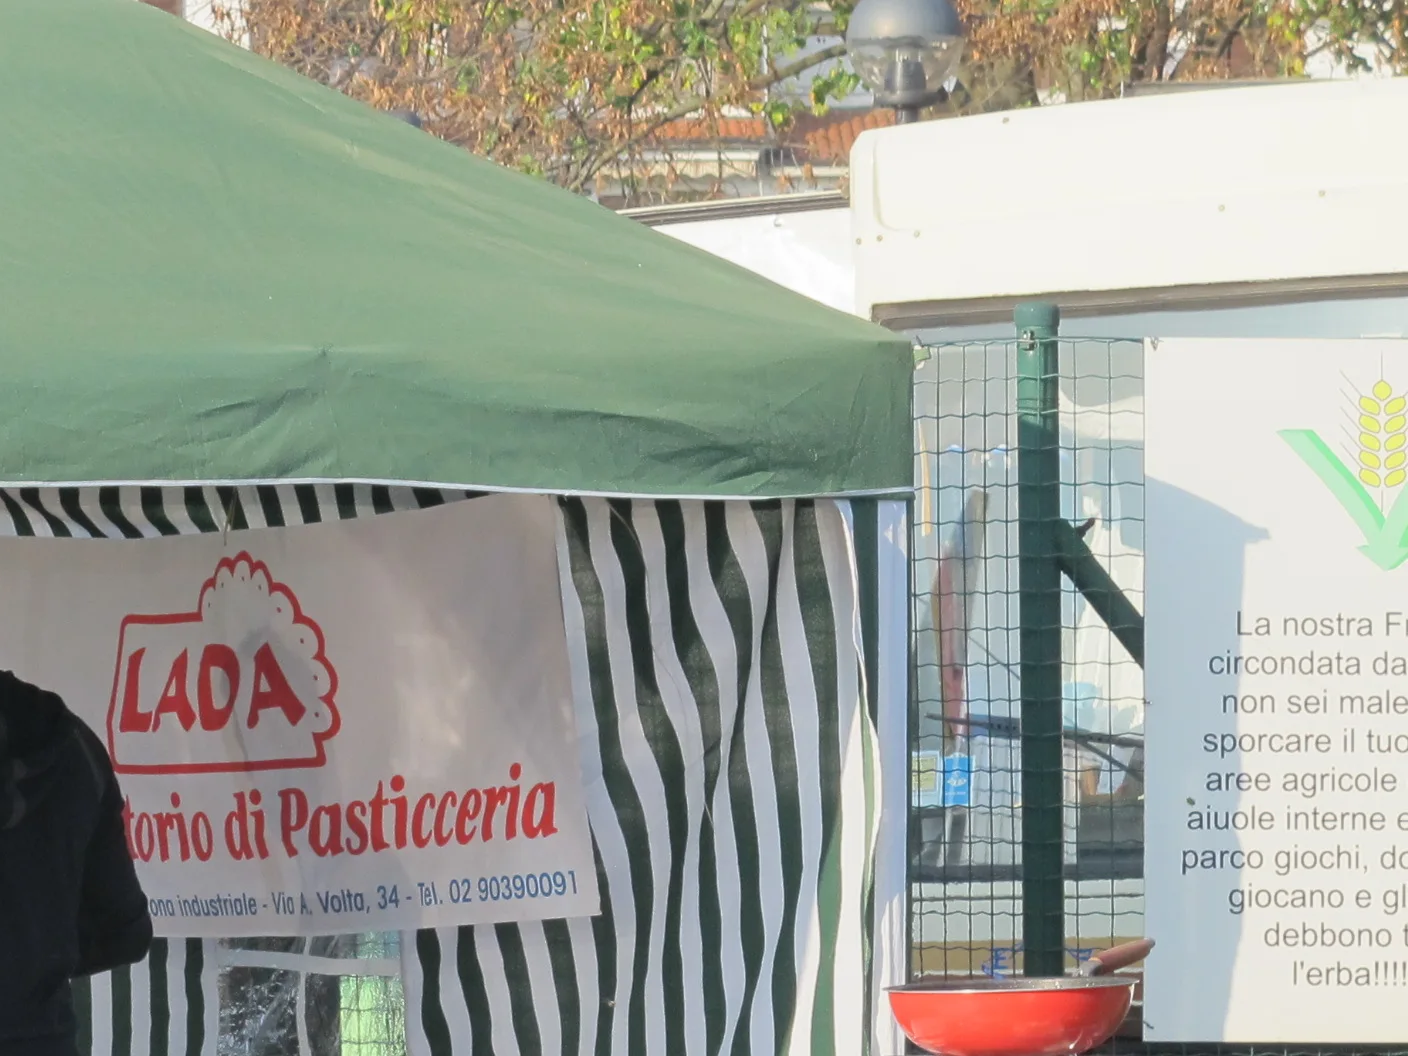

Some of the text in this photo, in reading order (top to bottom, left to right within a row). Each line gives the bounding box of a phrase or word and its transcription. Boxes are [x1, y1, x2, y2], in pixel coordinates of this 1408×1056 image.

[1237, 611, 1271, 636] La
[1283, 613, 1372, 636] nostra
[1208, 650, 1408, 675] circondata da
[119, 641, 306, 732] LADA
[1222, 689, 1408, 714] non sei male
[1203, 728, 1408, 758] sporcare il tuo
[1206, 766, 1397, 798] aree agricole
[225, 789, 269, 860] di
[278, 763, 558, 858] Pasticceria
[1187, 805, 1275, 830] aiuole
[1286, 805, 1386, 831] interne
[1181, 850, 1264, 875] parco
[1274, 844, 1368, 876] giochi,
[148, 900, 174, 917] ona
[178, 892, 257, 917] industriale
[271, 892, 293, 916] Via
[300, 891, 313, 915] A.
[317, 889, 371, 915] Volta,
[377, 885, 400, 910] 34
[417, 882, 443, 907] Tel.
[449, 879, 472, 903] 02
[478, 870, 577, 901] 90390091
[1227, 883, 1344, 914] giocano
[1355, 889, 1372, 908] e
[1264, 922, 1392, 947] debbono
